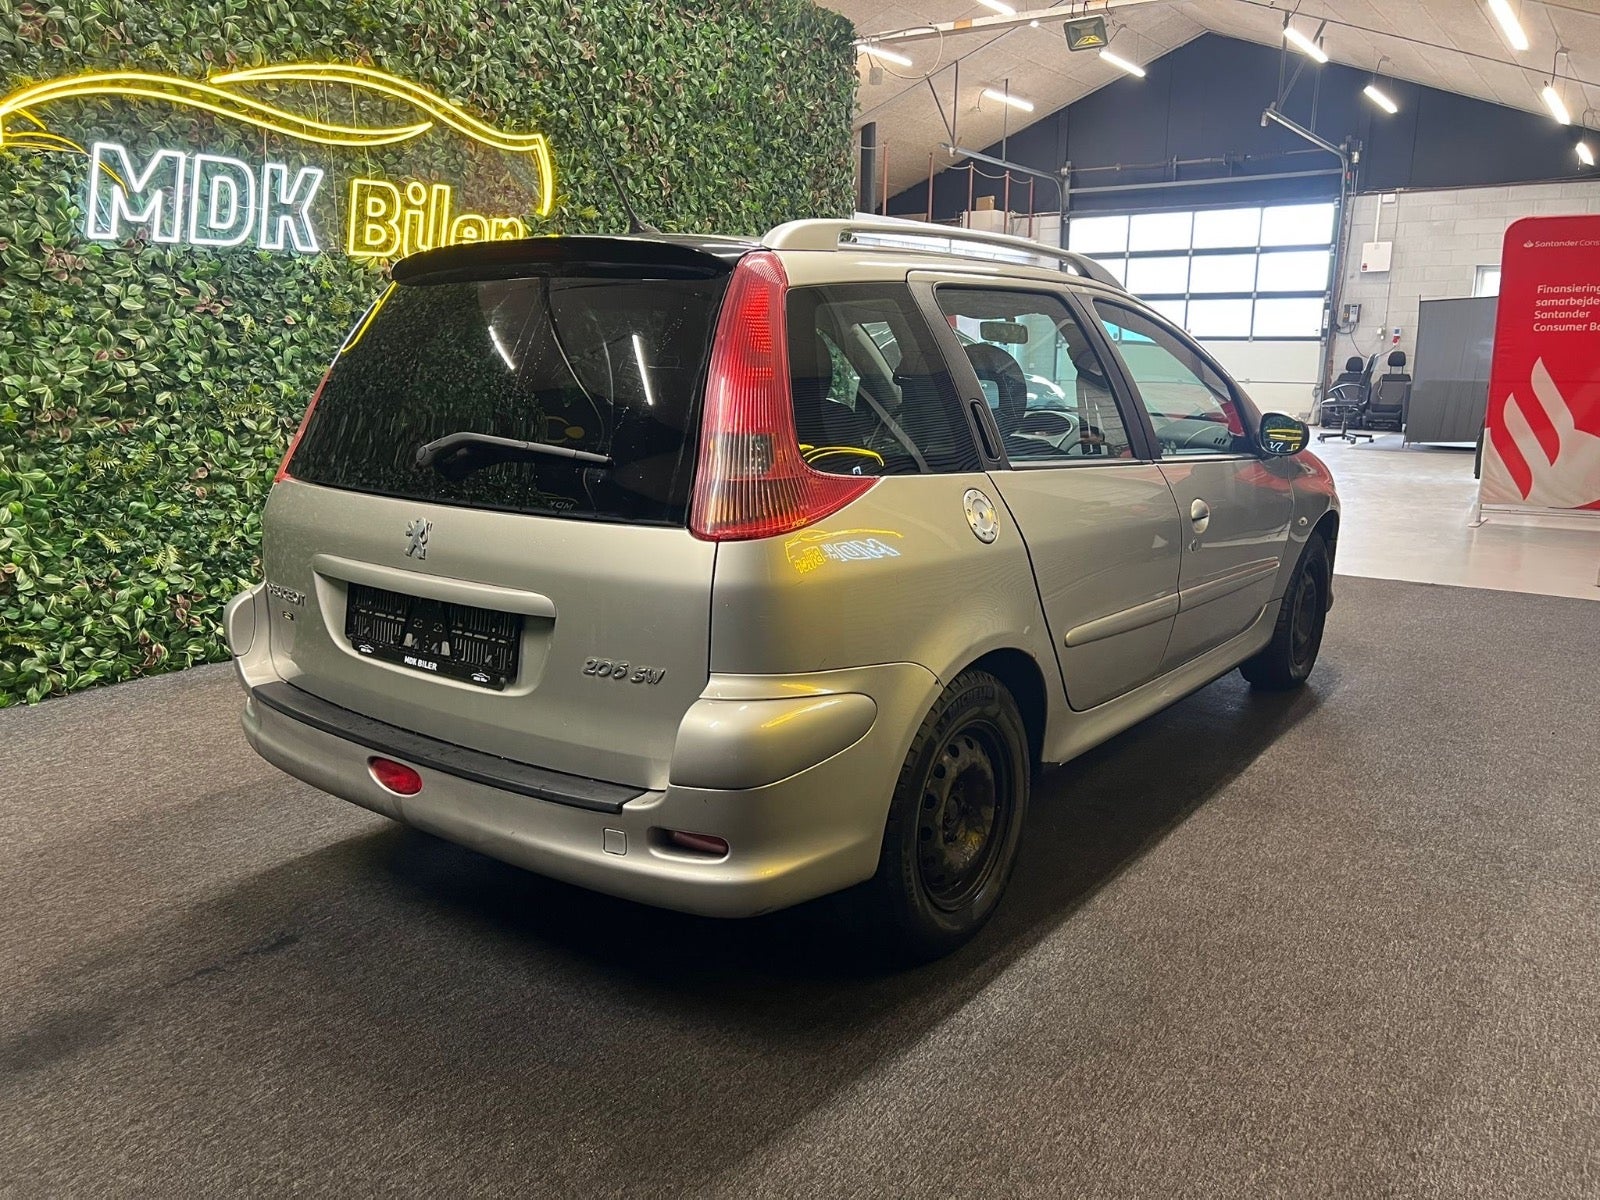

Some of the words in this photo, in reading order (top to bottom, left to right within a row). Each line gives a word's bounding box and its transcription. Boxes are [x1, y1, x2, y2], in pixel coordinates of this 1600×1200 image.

[87, 142, 324, 253] MDK
[1535, 240, 1578, 248] Santander
[1536, 297, 1600, 307] samarbejde
[1534, 310, 1591, 319] Santander
[1533, 323, 1587, 332] Consumer
[404, 655, 418, 666] MDK
[417, 659, 438, 671] BILER
[583, 658, 629, 680] 206
[630, 667, 666, 685] SW
